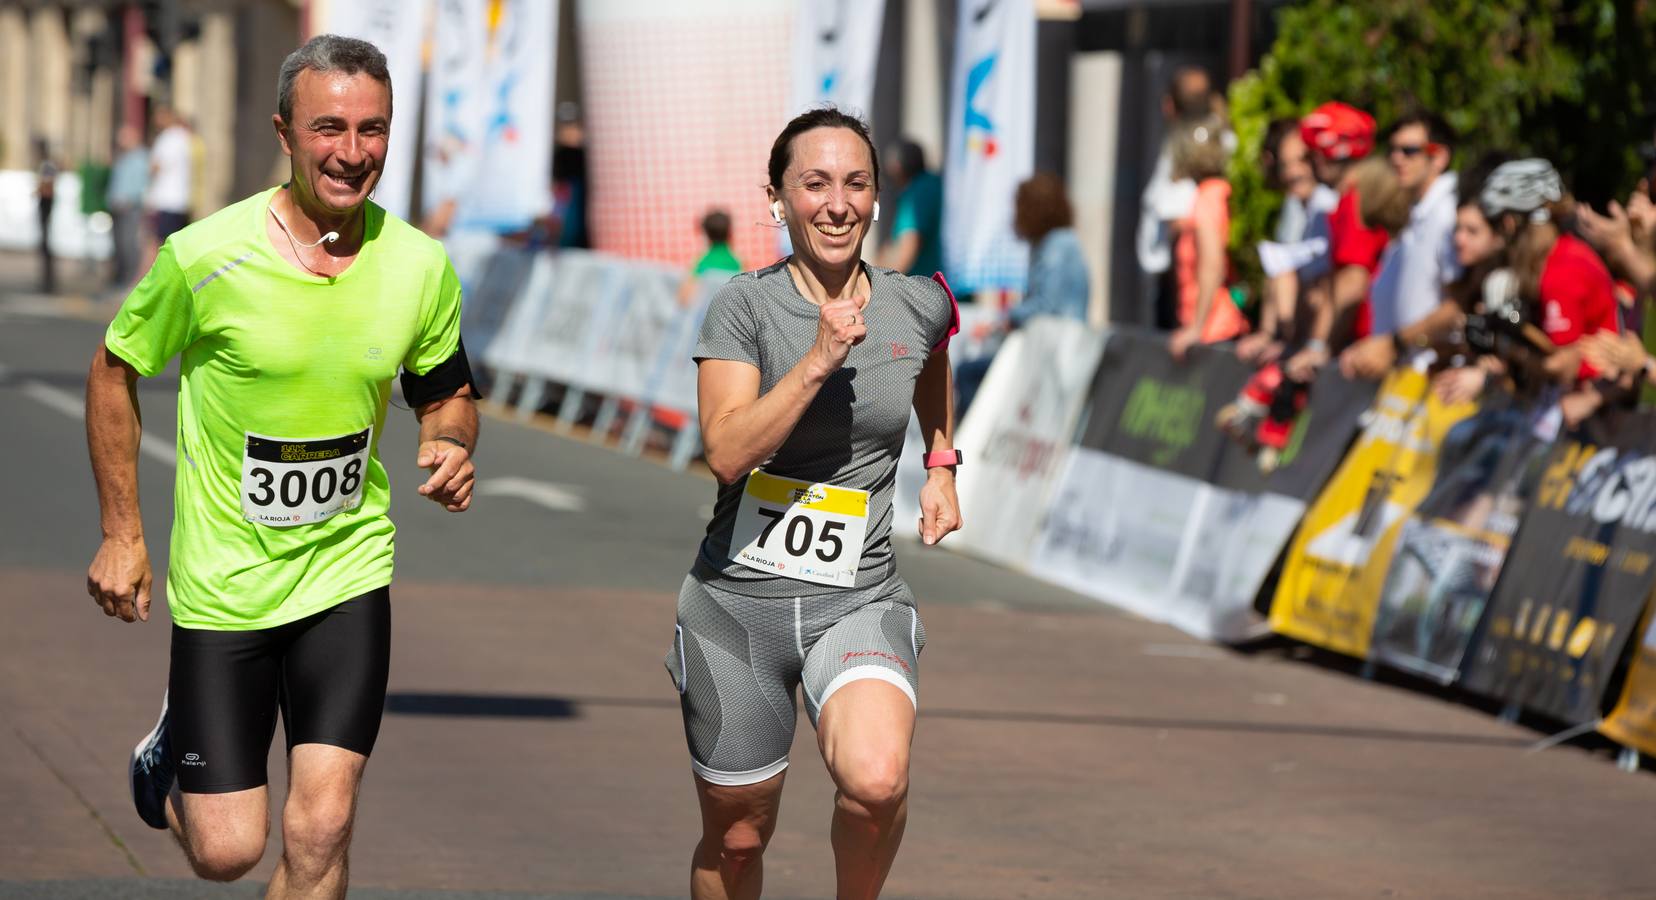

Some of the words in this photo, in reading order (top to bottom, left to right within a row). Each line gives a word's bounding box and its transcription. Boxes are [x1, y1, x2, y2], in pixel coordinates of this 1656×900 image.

[281, 444, 307, 453] 11K
[281, 448, 341, 461] CARRERA
[248, 458, 362, 508] 3008
[757, 506, 846, 563] 705
[756, 557, 775, 567] RIOJA
